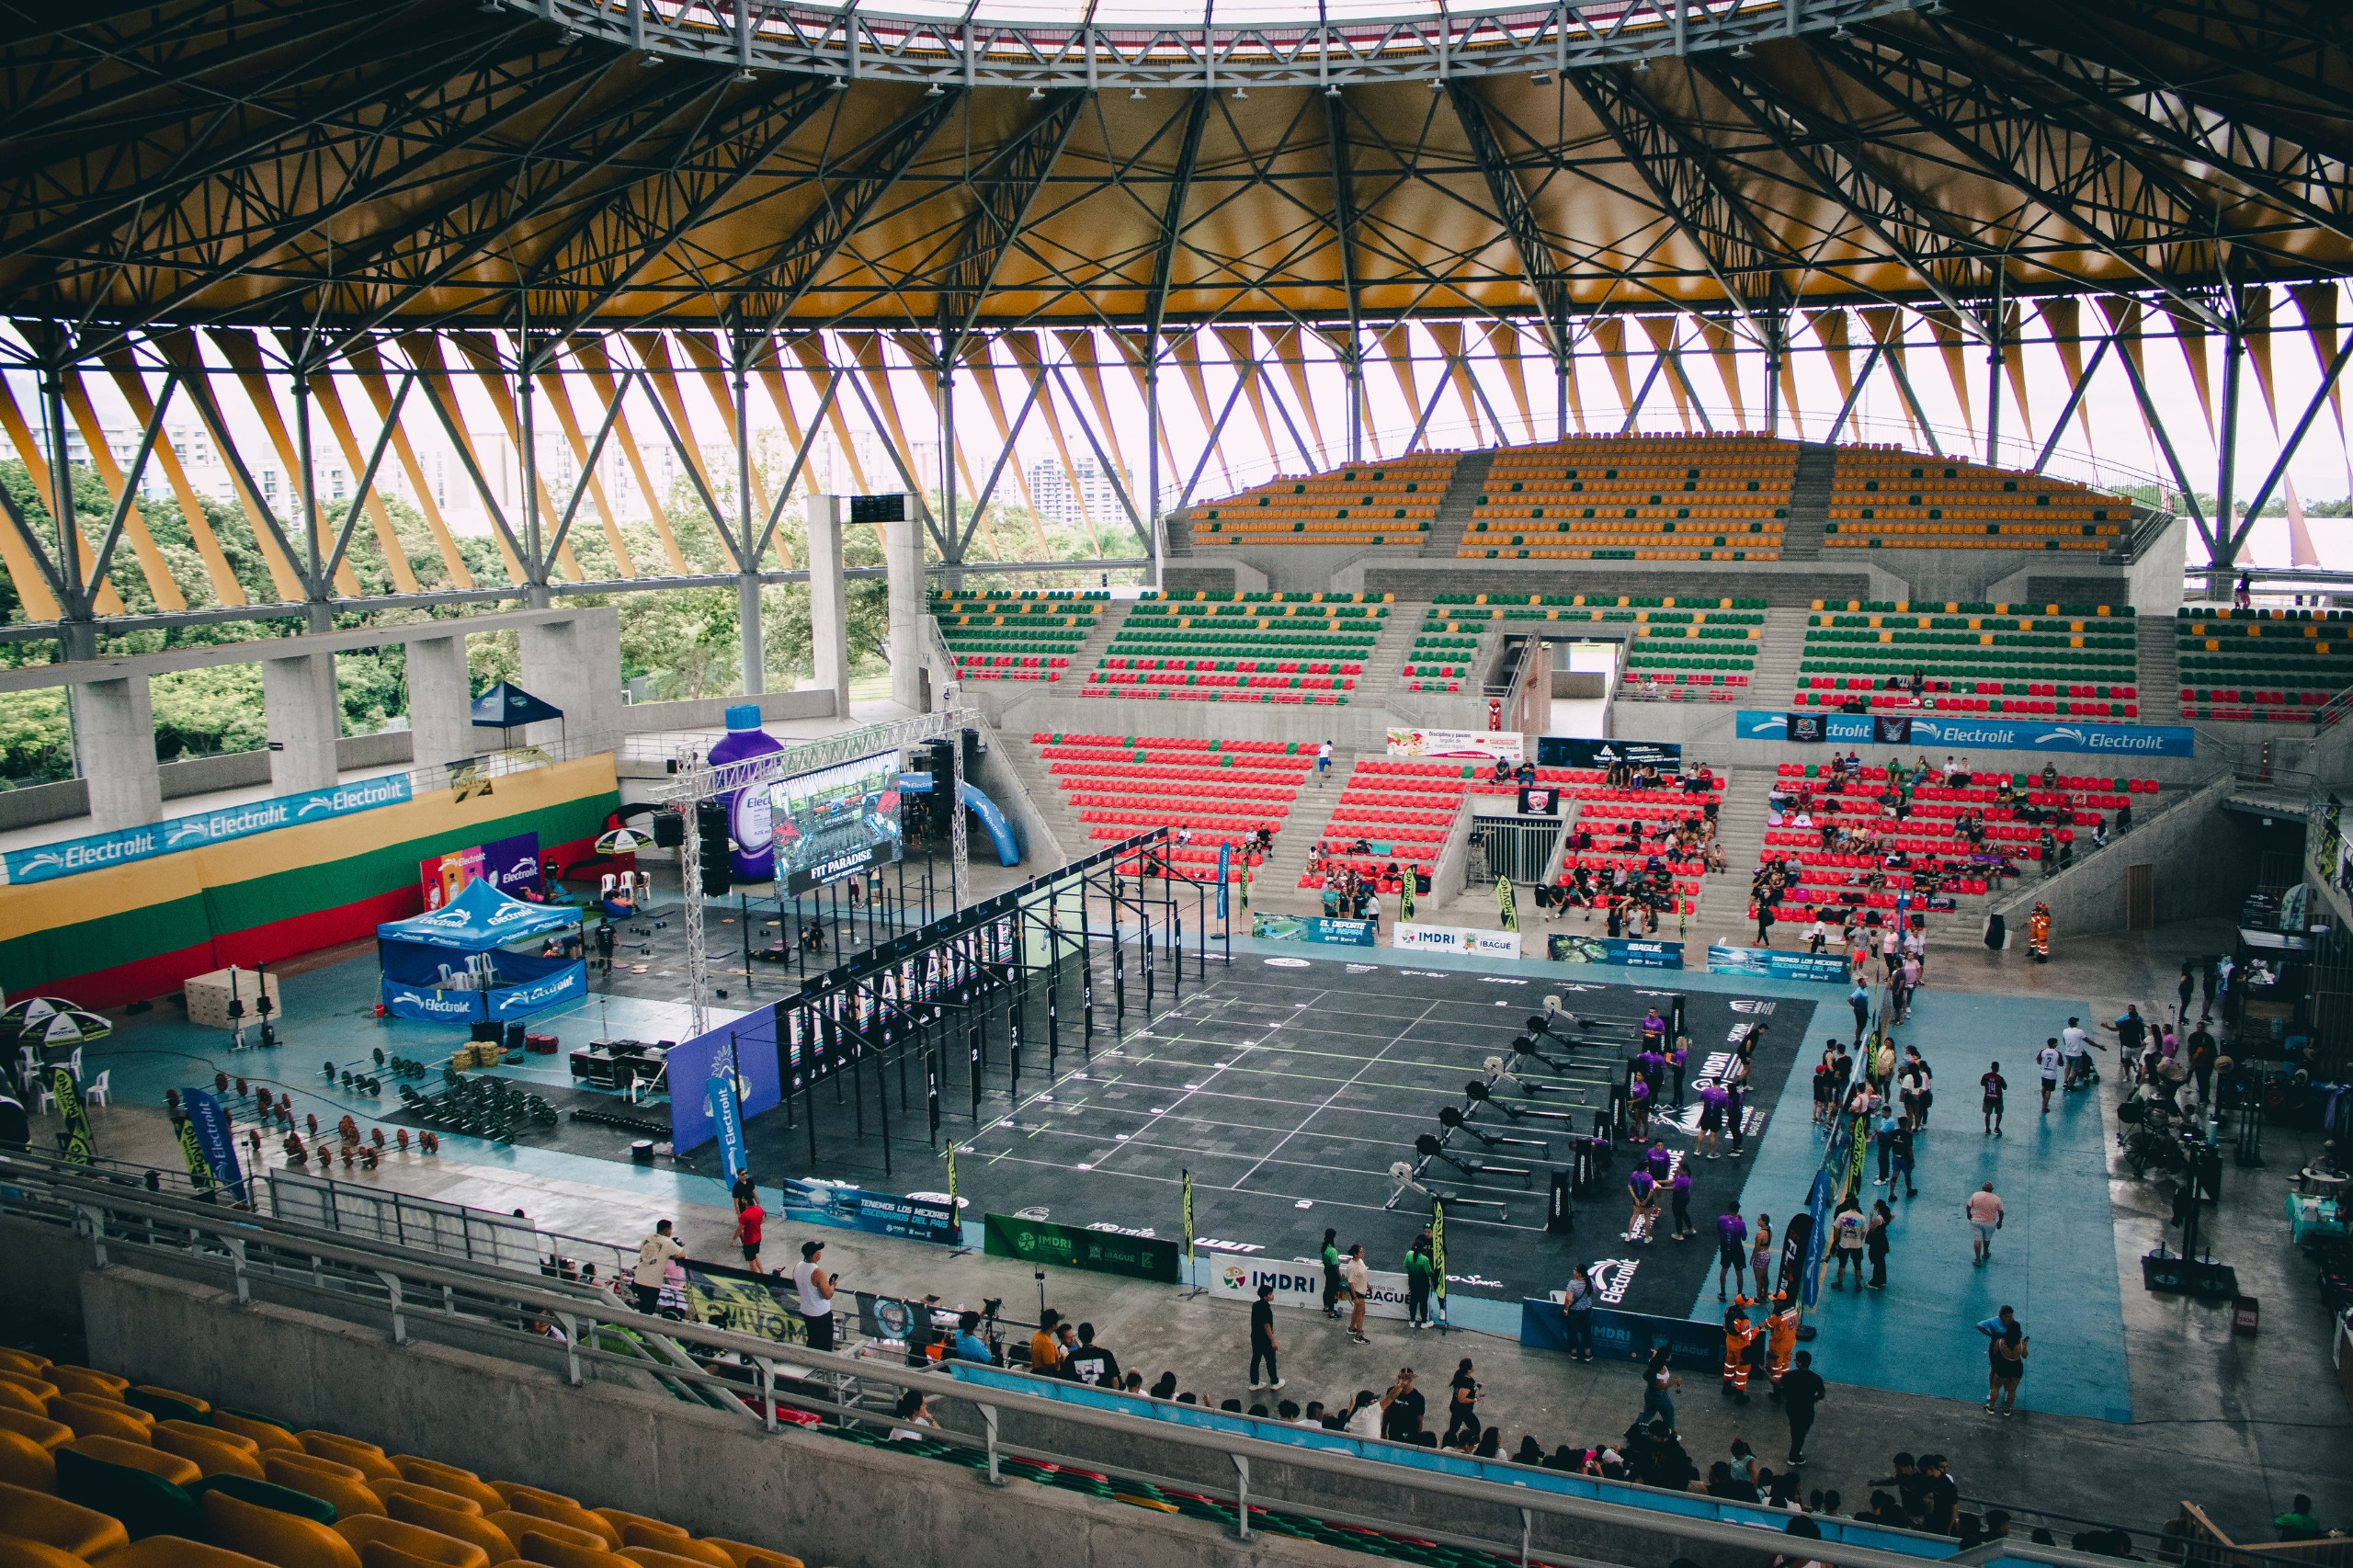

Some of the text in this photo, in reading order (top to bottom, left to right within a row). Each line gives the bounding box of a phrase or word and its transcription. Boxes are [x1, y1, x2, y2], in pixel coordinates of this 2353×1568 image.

[1943, 727, 2015, 744] Electrolit
[2089, 733, 2164, 749] Electrolit
[334, 781, 404, 811] Electrolit
[210, 805, 288, 837] Electrolit
[65, 832, 157, 869] Electrolit
[811, 864, 827, 880] FIT
[827, 848, 872, 873] PARADISE
[503, 867, 539, 884] Electrolit
[1404, 872, 1414, 906] MOVING
[1501, 880, 1513, 915] MOVING
[1331, 921, 1366, 930] DEPORTE
[916, 930, 923, 941] 2
[1176, 936, 1180, 946] 8
[1419, 932, 1455, 945] IMDRI
[1480, 940, 1511, 950] IBAGUÉ
[873, 949, 877, 960] 1
[1147, 952, 1153, 962] 7
[1772, 962, 1811, 971] ESCENARIOS
[822, 974, 832, 989] A
[1118, 969, 1122, 980] 6
[1085, 987, 1090, 999] 5
[425, 998, 471, 1013] Electrolit
[1050, 1006, 1055, 1017] 4
[1012, 1027, 1017, 1039] 3
[972, 1049, 978, 1062] 2
[1699, 1051, 1732, 1077] IMDRI
[930, 1074, 936, 1085] 1
[55, 1073, 78, 1119] MOVING
[1987, 1083, 1996, 1094] 14
[719, 1087, 735, 1145] Electrolit
[200, 1101, 227, 1160] Electrolit
[860, 1199, 895, 1210] TENEMOS
[897, 1205, 912, 1213] LOS
[914, 1209, 949, 1221] MEJORES
[860, 1208, 909, 1222] ESCENARIOS
[911, 1217, 926, 1226] DEL
[1039, 1234, 1072, 1248] IMDRI
[1105, 1251, 1135, 1263] IBAGUÉ
[1253, 1270, 1314, 1294] IMDRI
[1599, 1258, 1640, 1303] Electrolit
[1365, 1290, 1412, 1305] BAGUÉ
